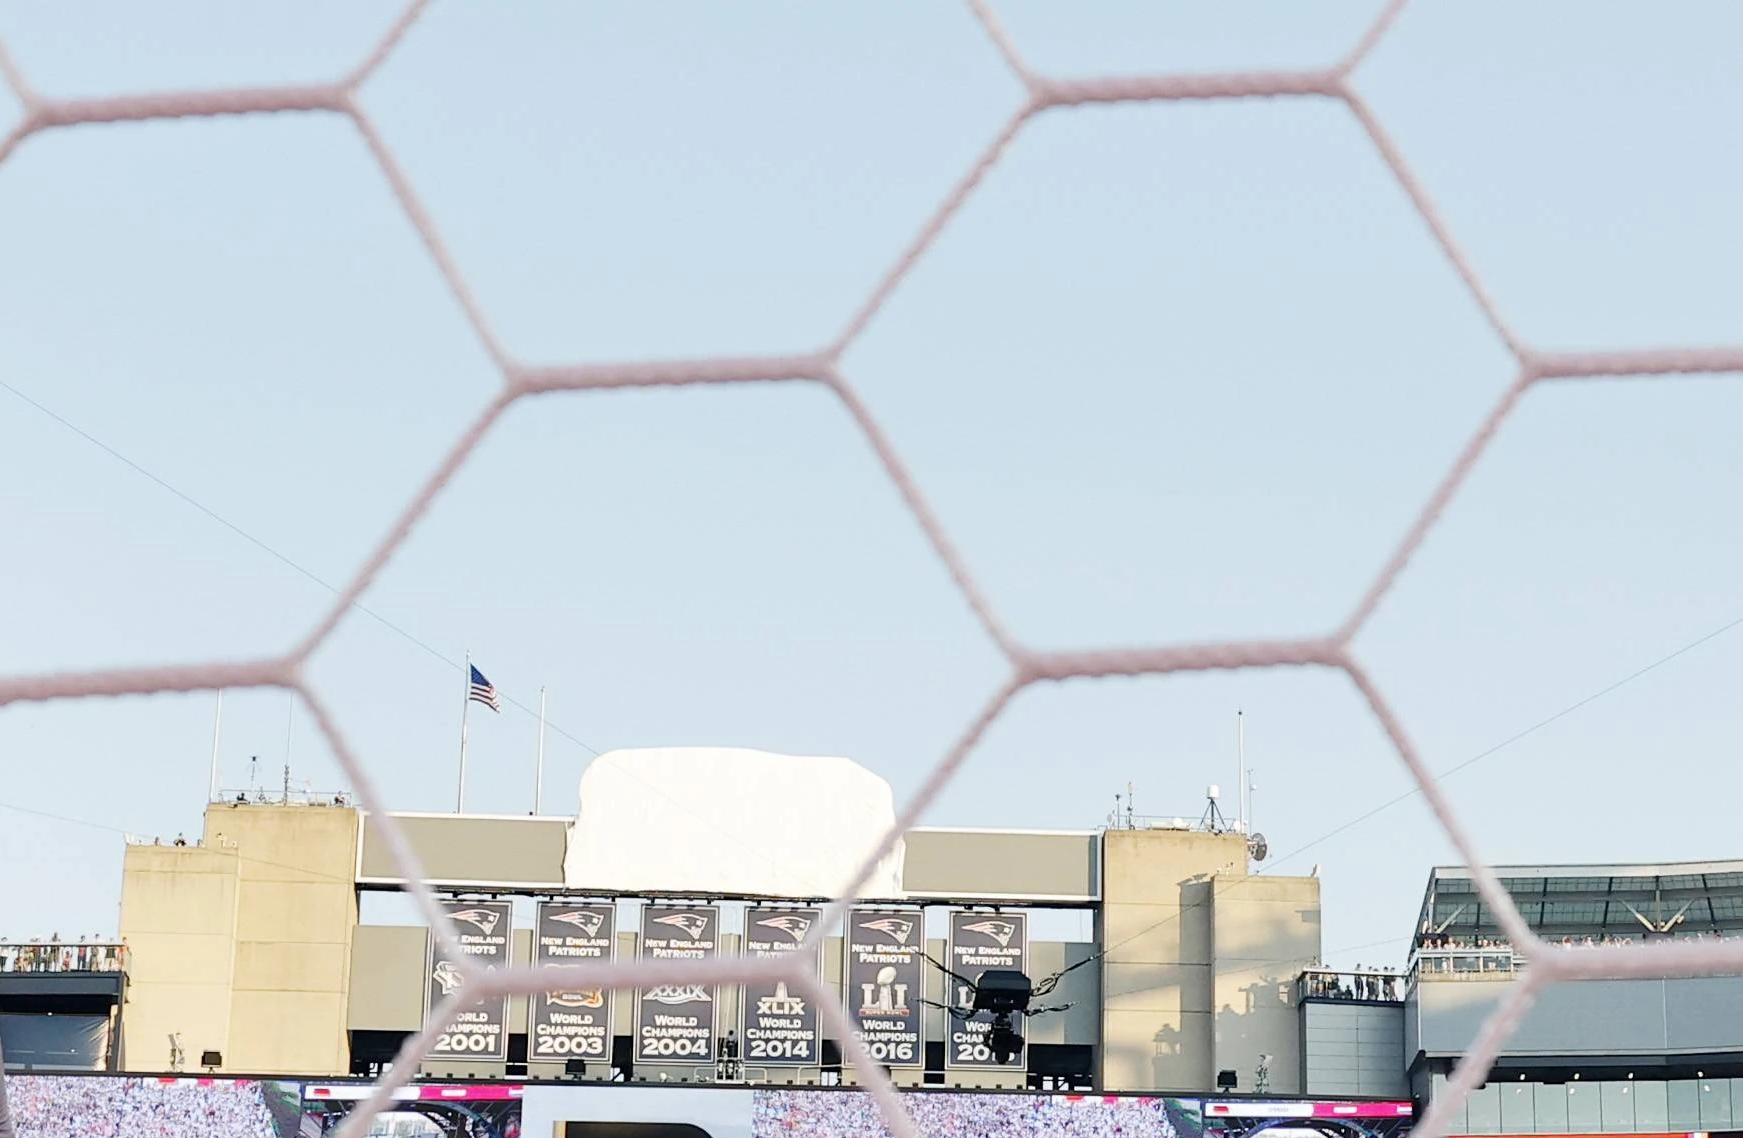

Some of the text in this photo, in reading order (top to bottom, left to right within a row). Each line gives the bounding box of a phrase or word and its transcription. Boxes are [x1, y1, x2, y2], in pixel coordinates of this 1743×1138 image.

[461, 934, 506, 945] ENGLAND
[541, 937, 609, 947] NEW ENGLAND
[645, 939, 713, 949] NEW ENGLAND
[748, 941, 770, 950] NEW
[852, 944, 919, 954] NEW ENGLAND
[954, 946, 1021, 956] NEW ENGLAND
[548, 946, 601, 957] PATRIOTS
[653, 949, 705, 959] PATRIOTS
[859, 952, 911, 964] PATRIOTS
[962, 955, 1013, 966] PATRIOTS
[757, 1001, 805, 1015] XLIX
[457, 1013, 488, 1022] ORLD
[550, 1013, 593, 1023] WORLD
[654, 1015, 697, 1026] WORLD
[759, 1017, 801, 1028] WORLD
[445, 1024, 500, 1034] AMPIONS
[862, 1019, 905, 1030] WORLD
[537, 1025, 605, 1036] CHAMPIONS
[642, 1027, 710, 1038] CHAMPIONS
[747, 1029, 813, 1040] CHAMPIONS
[434, 1034, 497, 1052] 2001
[537, 1037, 603, 1054] 2003
[642, 1039, 708, 1056] 2004
[750, 1041, 810, 1058] 2014
